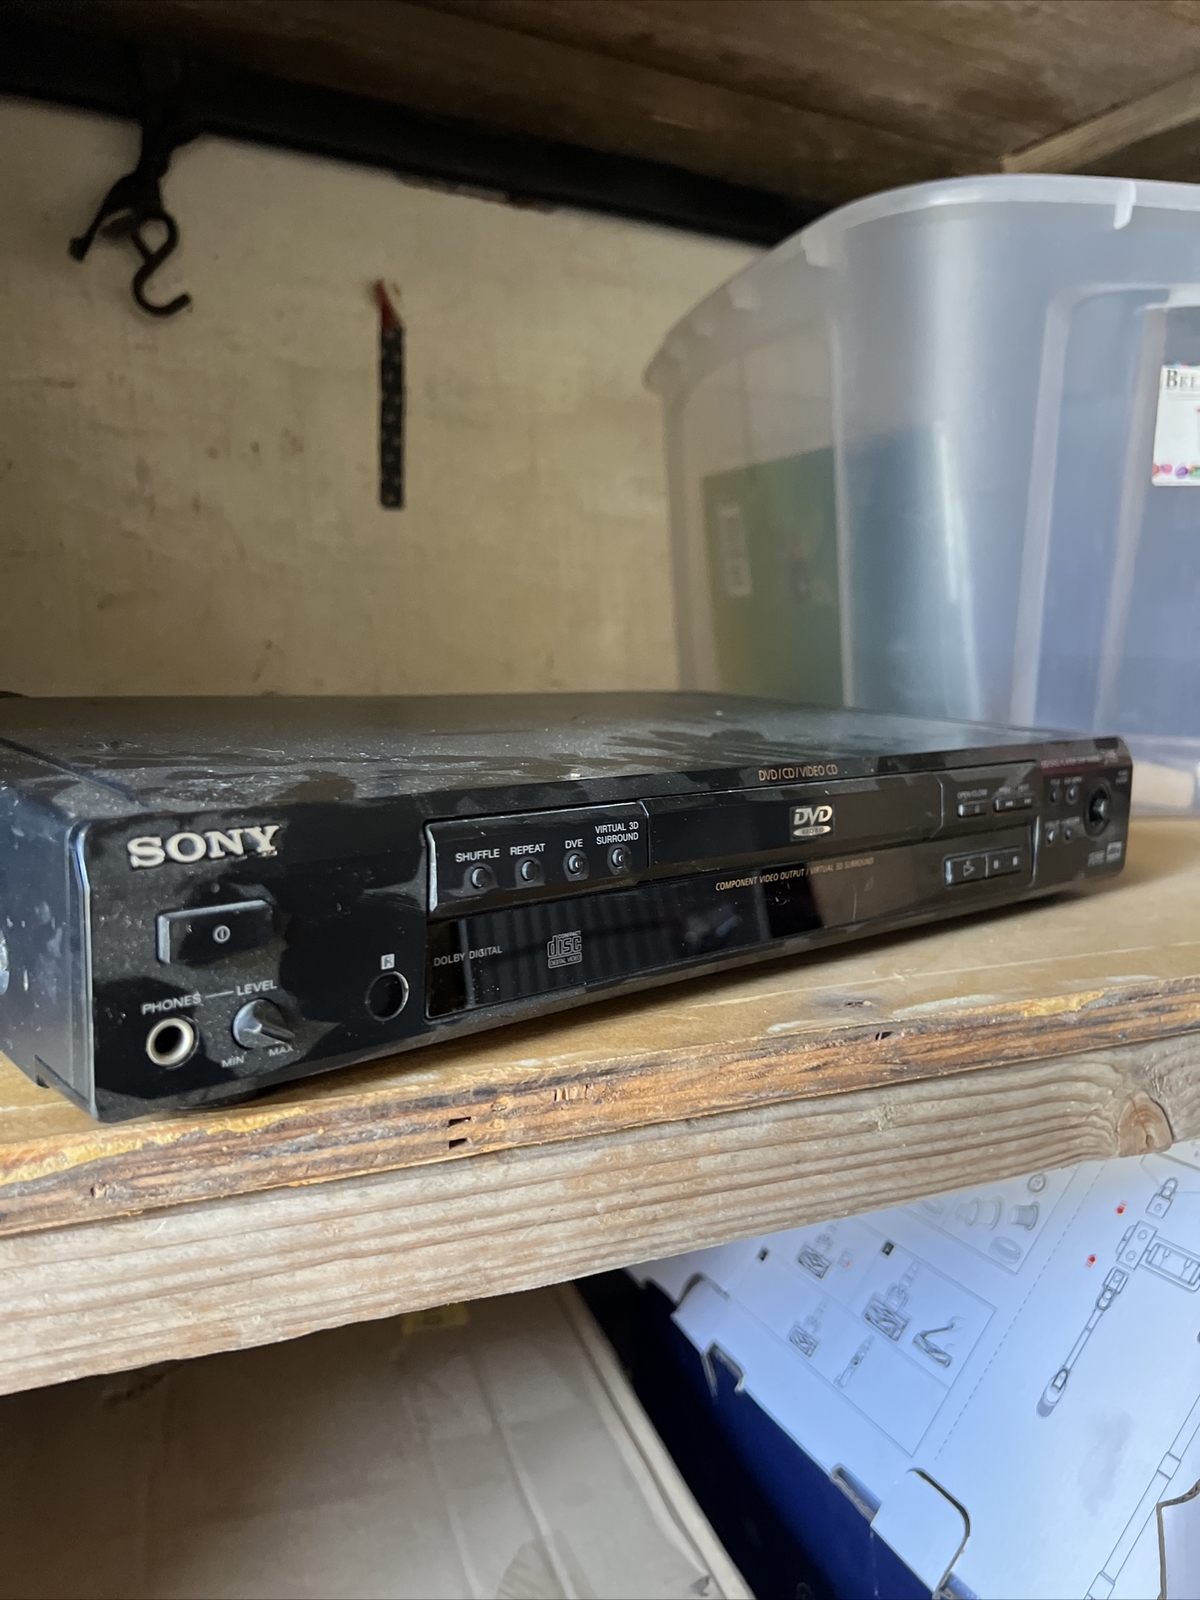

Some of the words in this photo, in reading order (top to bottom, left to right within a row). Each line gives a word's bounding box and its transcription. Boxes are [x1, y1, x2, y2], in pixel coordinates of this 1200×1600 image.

[825, 763, 838, 775] CD
[794, 805, 833, 826] DVD
[595, 822, 626, 834] VIRTUAL
[628, 821, 639, 831] 3D
[565, 838, 584, 849] DVE
[596, 832, 639, 845] SURROUND
[127, 825, 279, 868] SONY
[510, 843, 545, 856] REPEAT
[455, 848, 500, 863] SHUFFLE
[715, 876, 758, 891] COMPONENT
[759, 873, 779, 884] VIDEO
[780, 869, 805, 881] OUTPUT
[810, 863, 834, 876] VIRTUAL
[844, 857, 874, 869] SURROUND
[433, 952, 465, 967] DOLBY
[468, 945, 502, 960] DIGITAL
[141, 993, 202, 1015] PHONES
[236, 979, 278, 997] LEVEL
[268, 1044, 294, 1058] MAX
[221, 1054, 245, 1068] MIN
